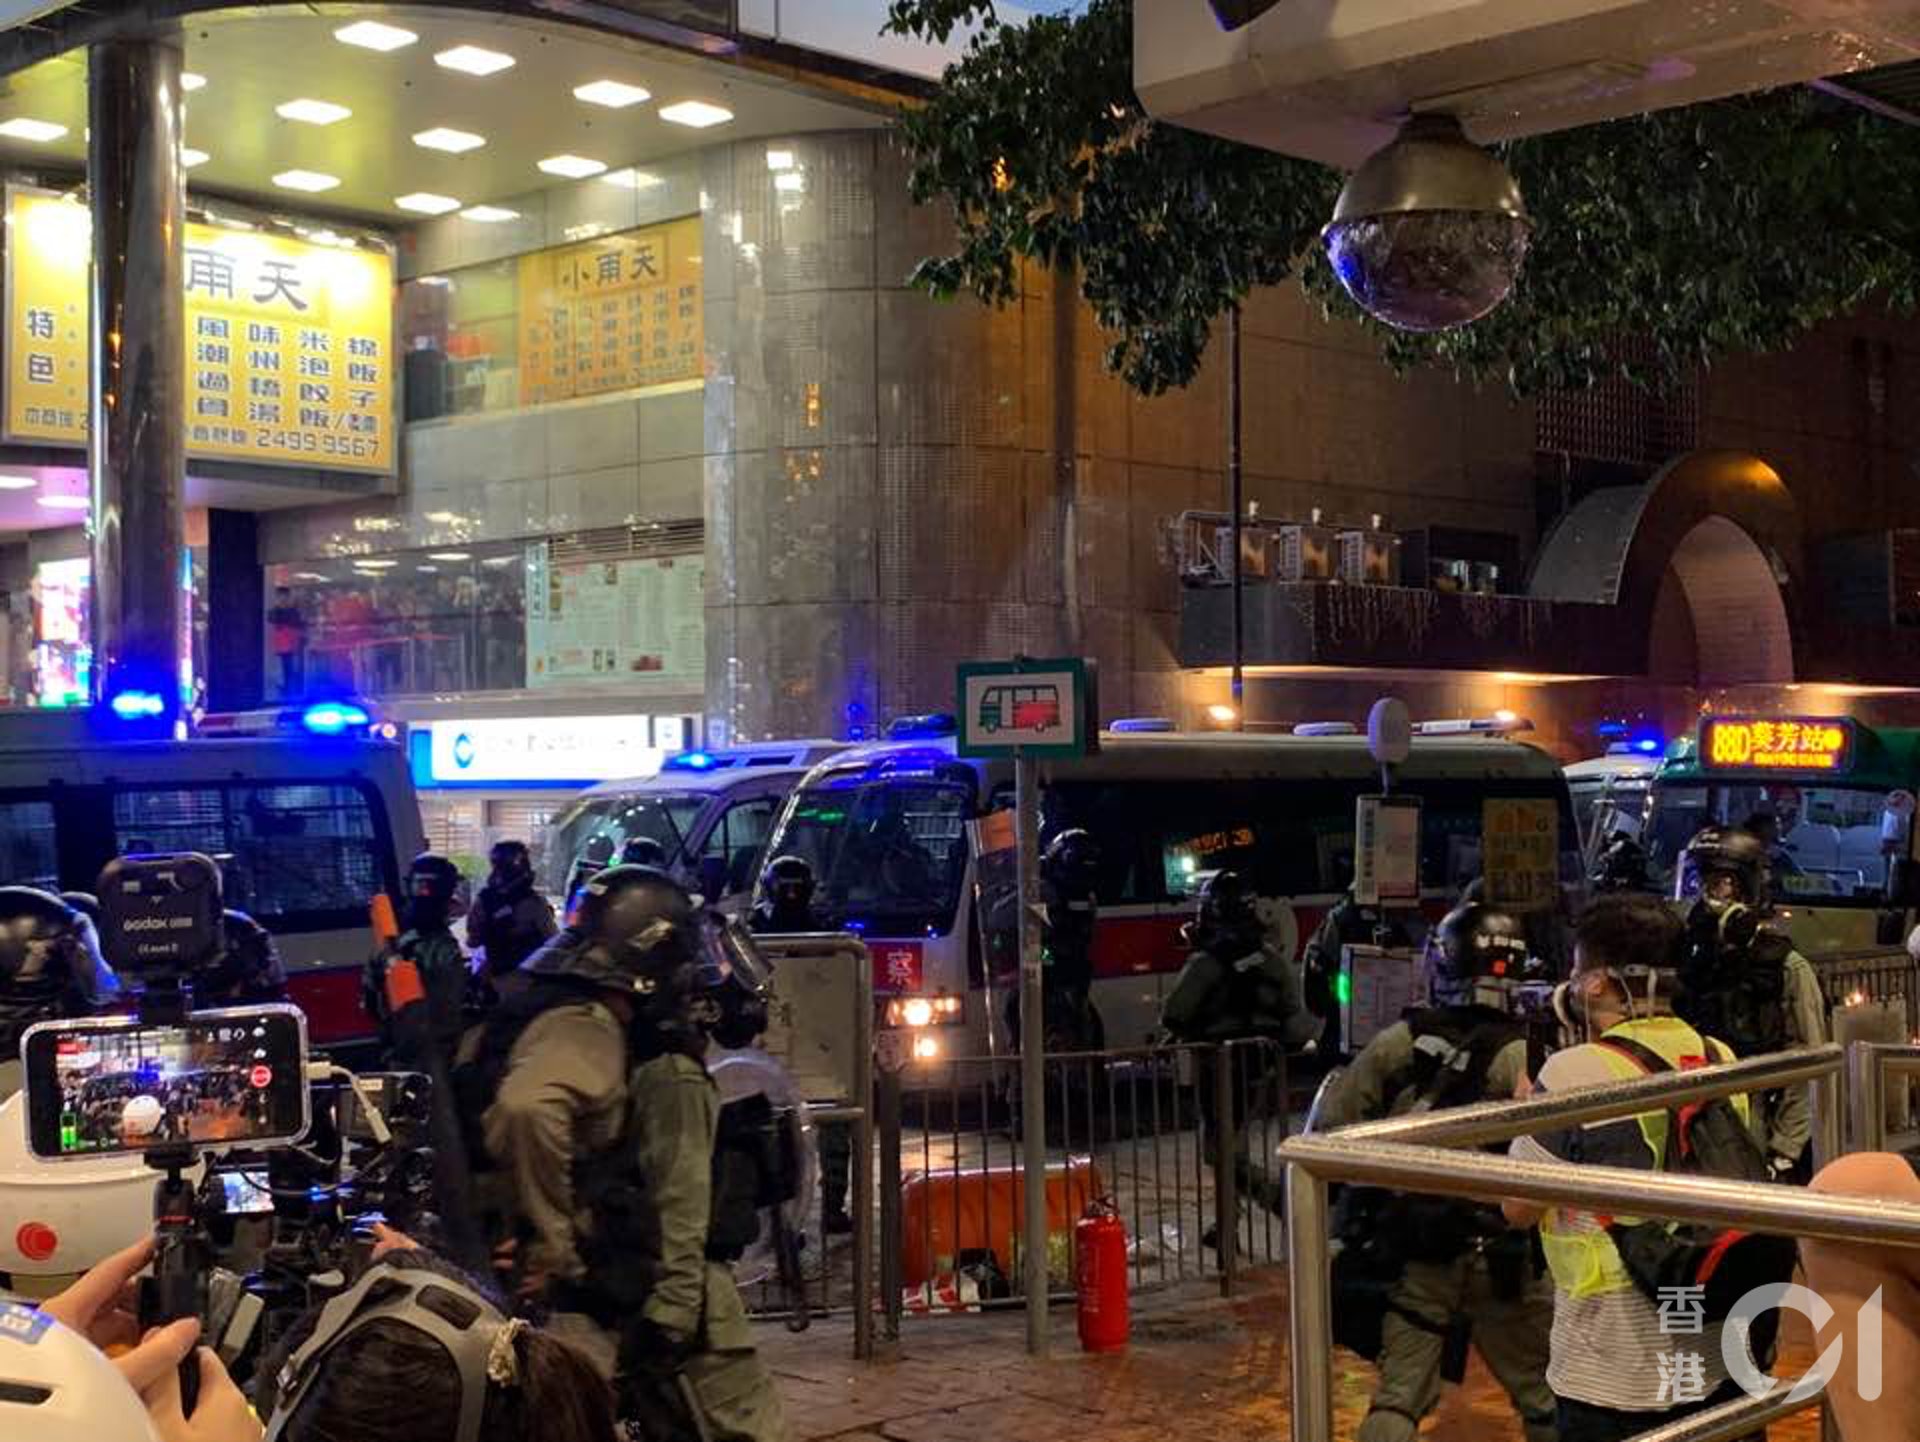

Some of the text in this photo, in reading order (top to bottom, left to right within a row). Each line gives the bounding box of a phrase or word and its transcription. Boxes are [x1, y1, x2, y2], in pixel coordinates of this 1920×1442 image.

[563, 245, 657, 292] 小雨天
[28, 308, 54, 384] 特色
